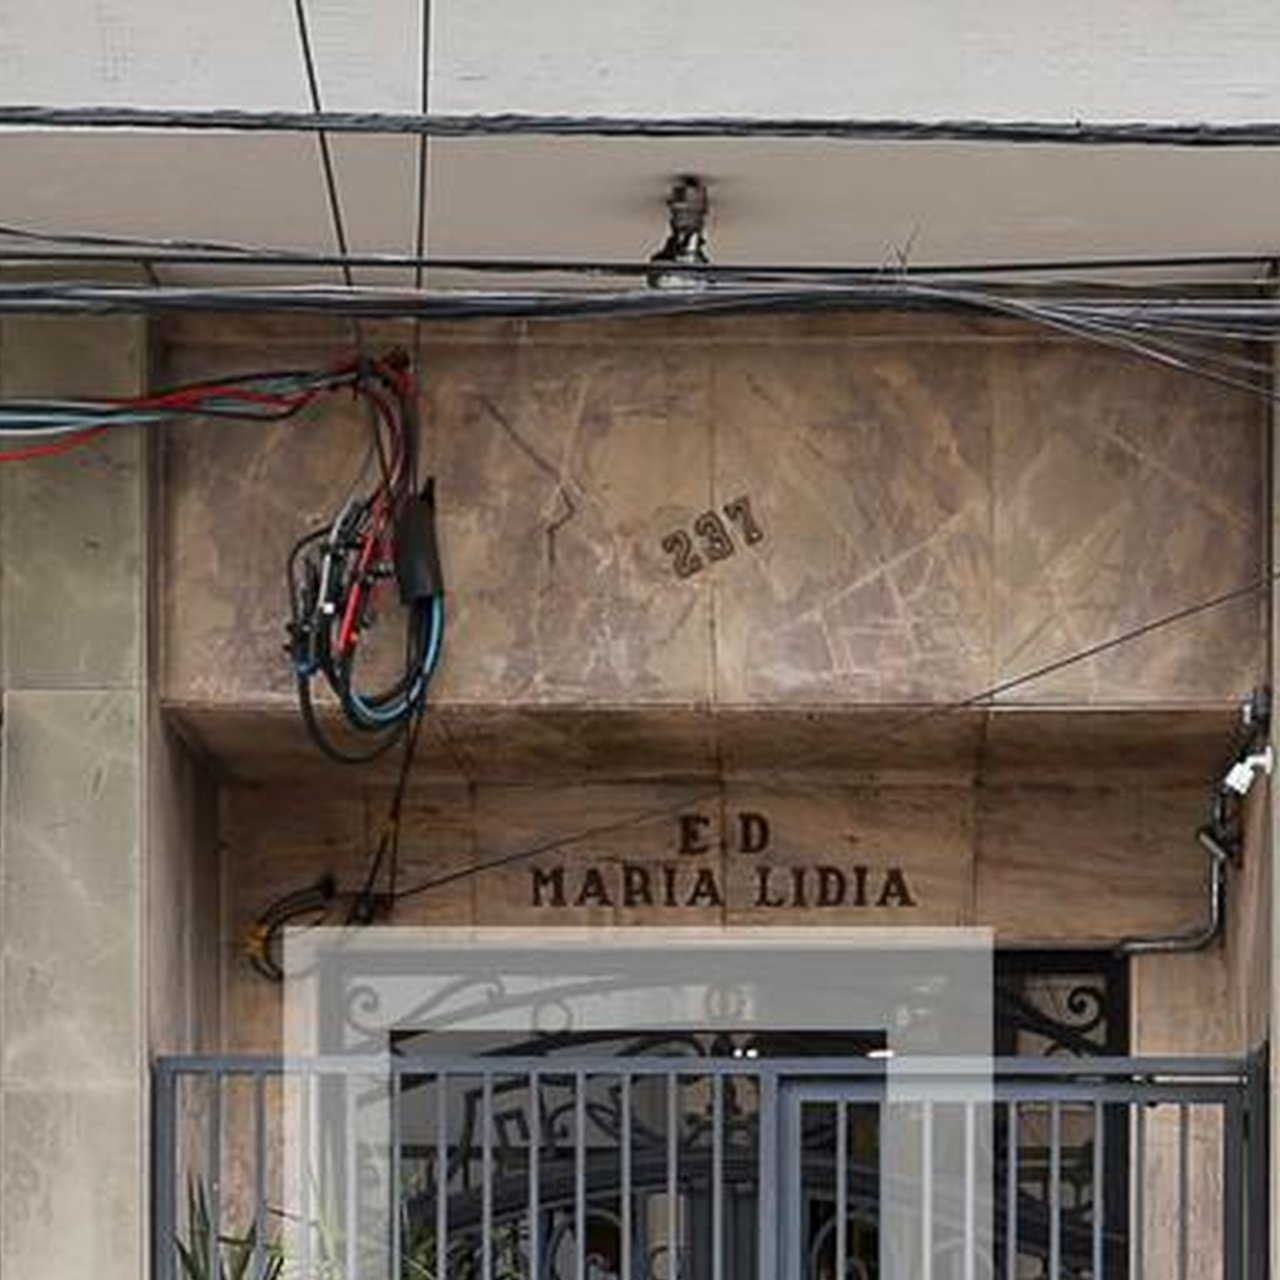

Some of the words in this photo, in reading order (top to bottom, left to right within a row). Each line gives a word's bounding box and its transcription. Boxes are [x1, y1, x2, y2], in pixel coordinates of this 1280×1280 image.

[661, 496, 764, 579] 237
[531, 866, 724, 907] MARIA
[755, 866, 918, 907] LIDIA
